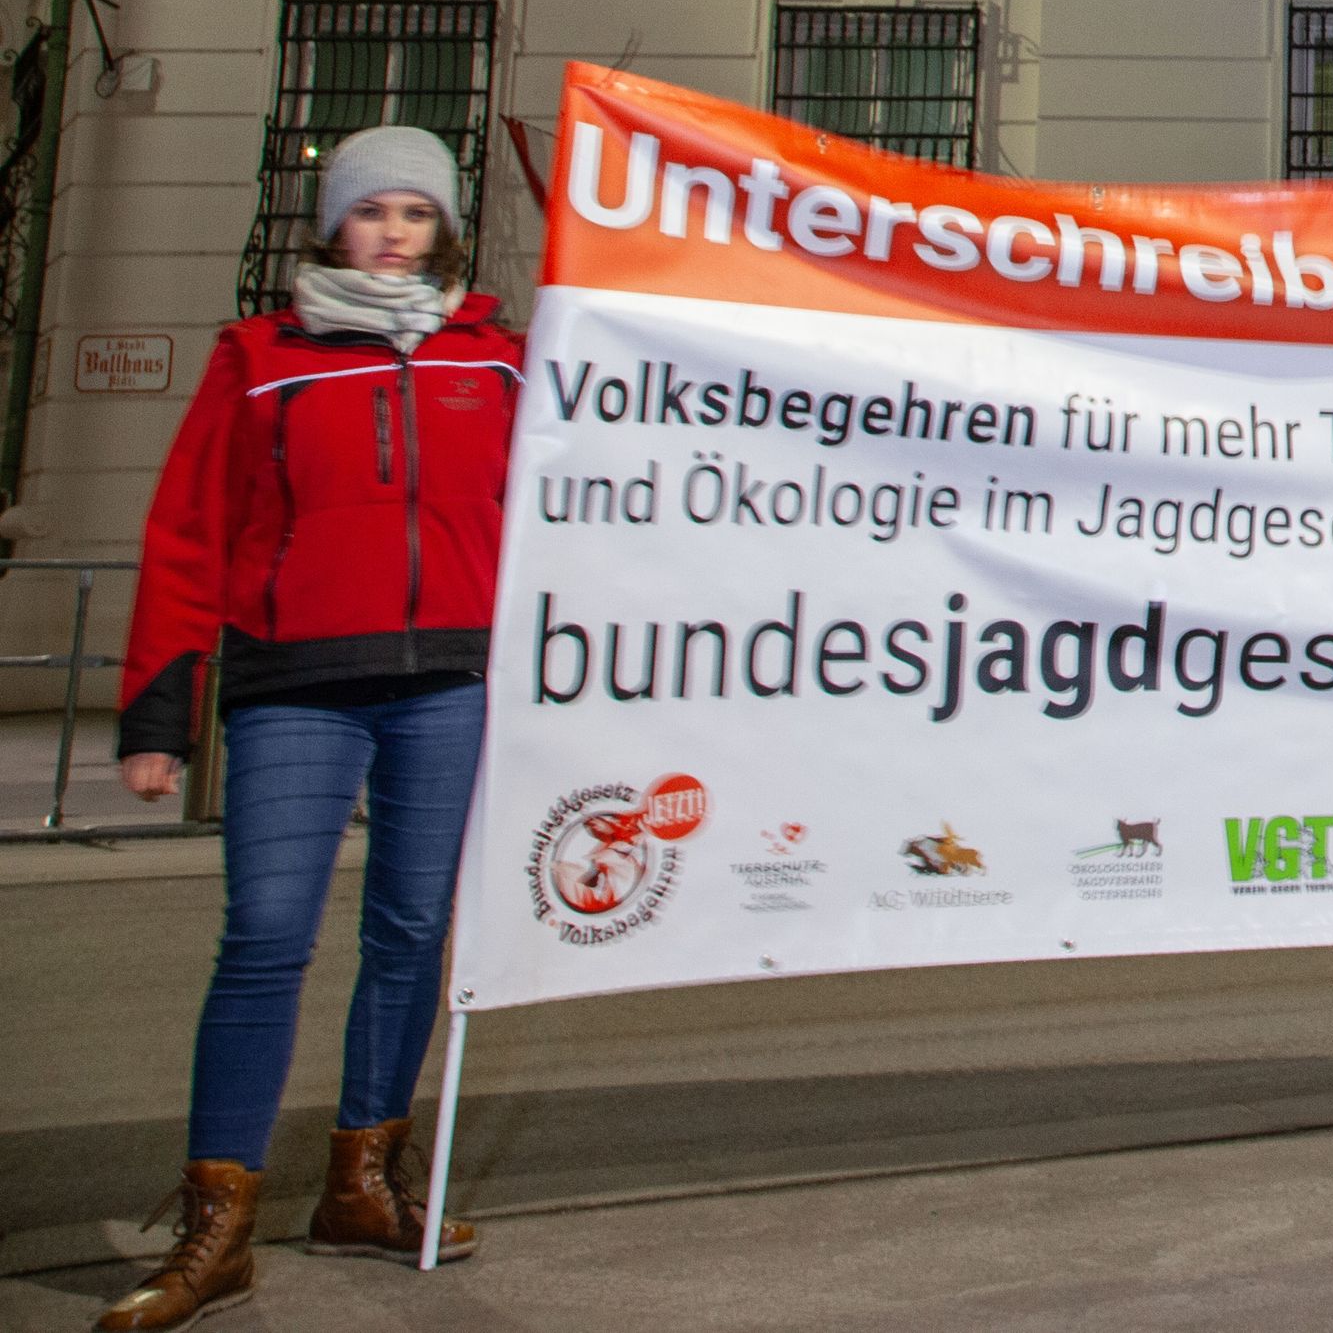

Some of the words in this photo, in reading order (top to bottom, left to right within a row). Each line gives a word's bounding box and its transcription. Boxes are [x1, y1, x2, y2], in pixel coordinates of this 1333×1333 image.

[545, 359, 1037, 449] Volksbegehren
[1061, 392, 1140, 453] für
[1161, 403, 1301, 462] mehr
[539, 459, 660, 526] und
[682, 451, 961, 542] Ökologie
[983, 475, 1055, 536] im
[643, 787, 705, 827] JETZT!
